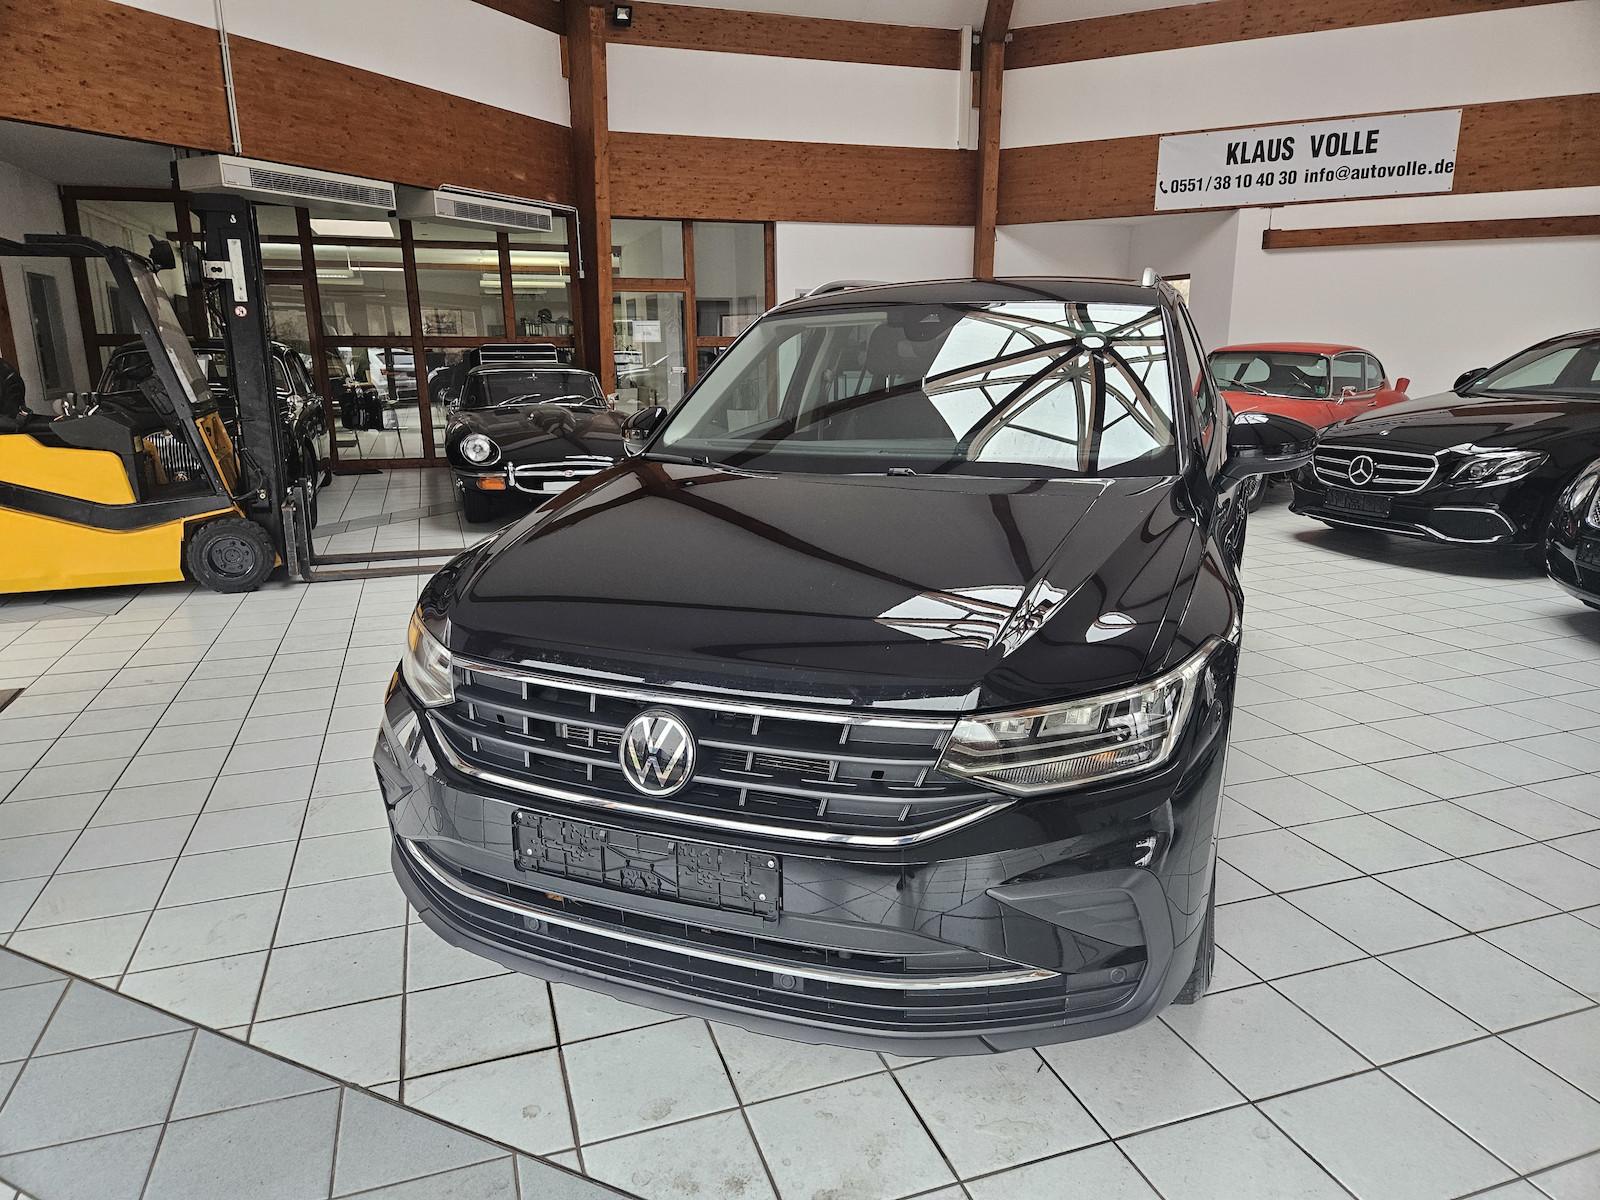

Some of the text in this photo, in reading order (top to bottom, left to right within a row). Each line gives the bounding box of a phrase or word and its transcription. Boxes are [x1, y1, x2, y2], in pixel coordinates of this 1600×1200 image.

[1226, 129, 1380, 166] KLAUS VOLLE
[1235, 174, 1251, 188] 10
[1255, 172, 1275, 187] 40
[1278, 170, 1297, 185] 30
[1304, 159, 1454, 183] info@autovolle.de
